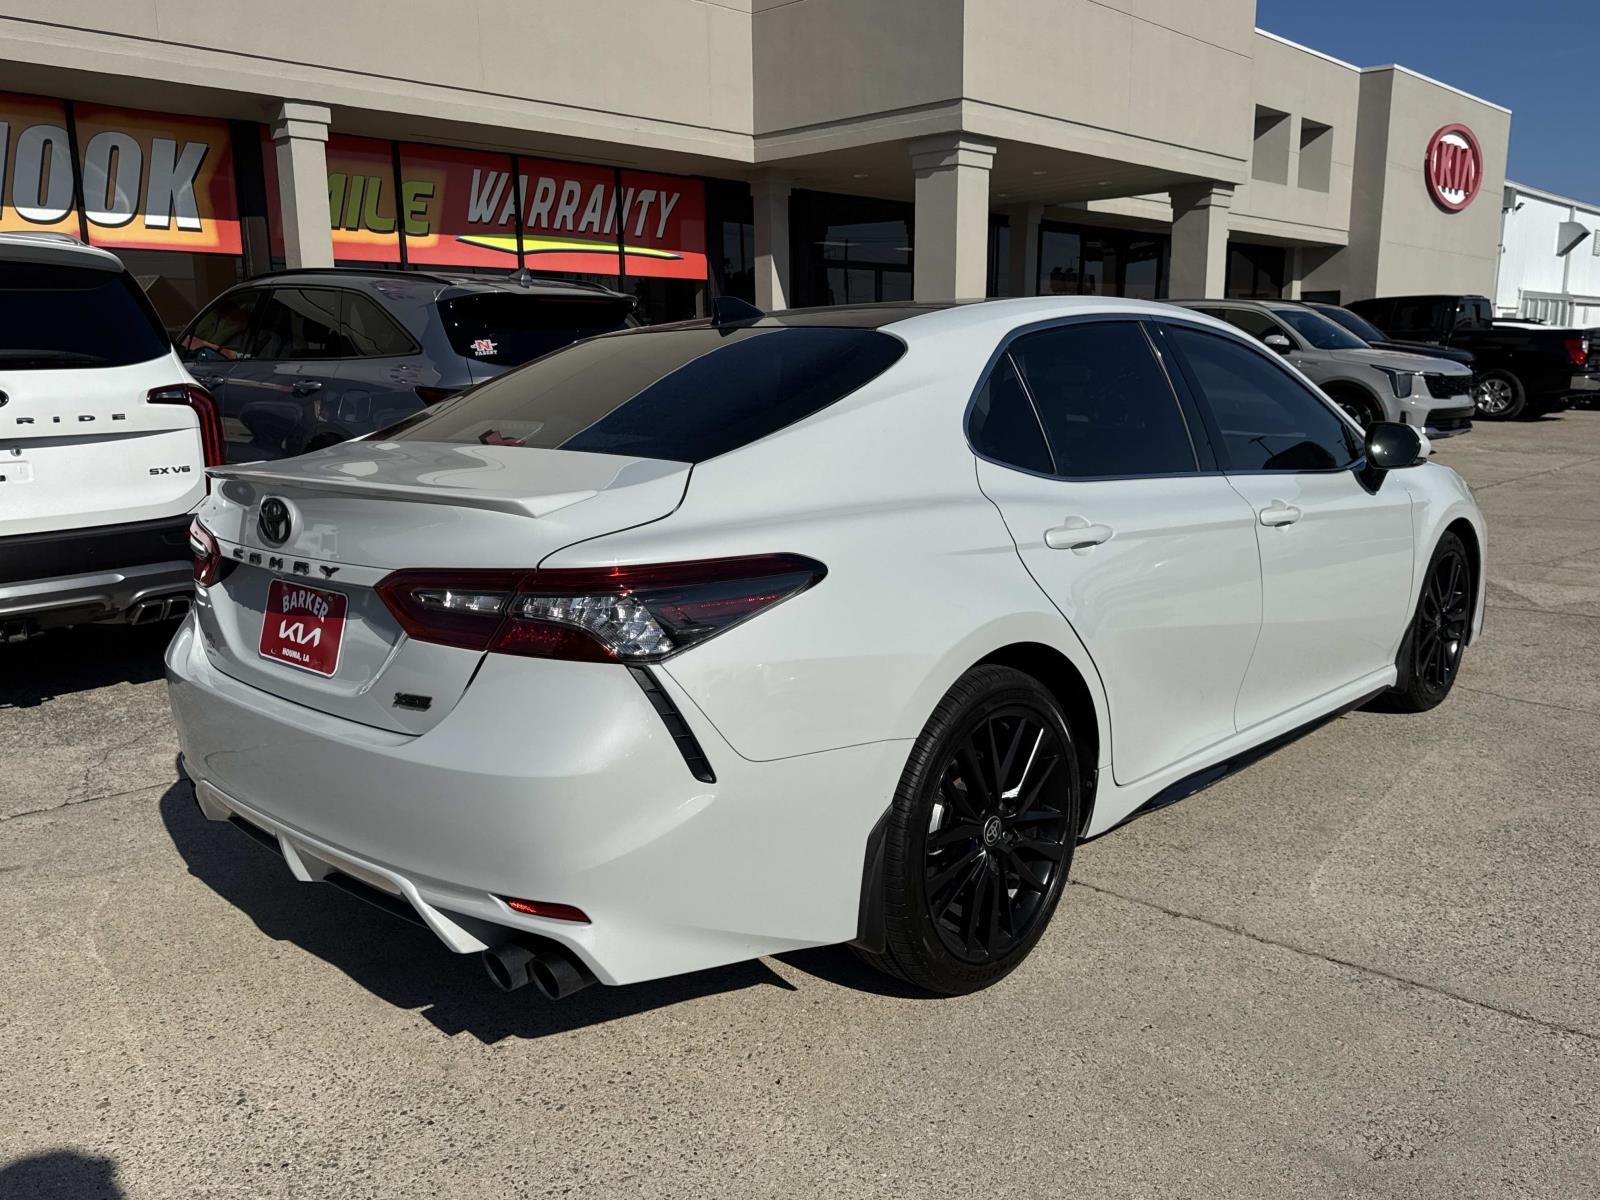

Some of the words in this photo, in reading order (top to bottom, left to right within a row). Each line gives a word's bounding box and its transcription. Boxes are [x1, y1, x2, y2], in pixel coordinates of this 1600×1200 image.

[1436, 141, 1474, 194] KIA
[467, 168, 681, 239] WARRANTY
[150, 467, 169, 475] SX
[172, 465, 191, 474] V6
[233, 548, 340, 580] CAMRY
[282, 590, 329, 623] BARKER
[302, 653, 310, 663] LA
